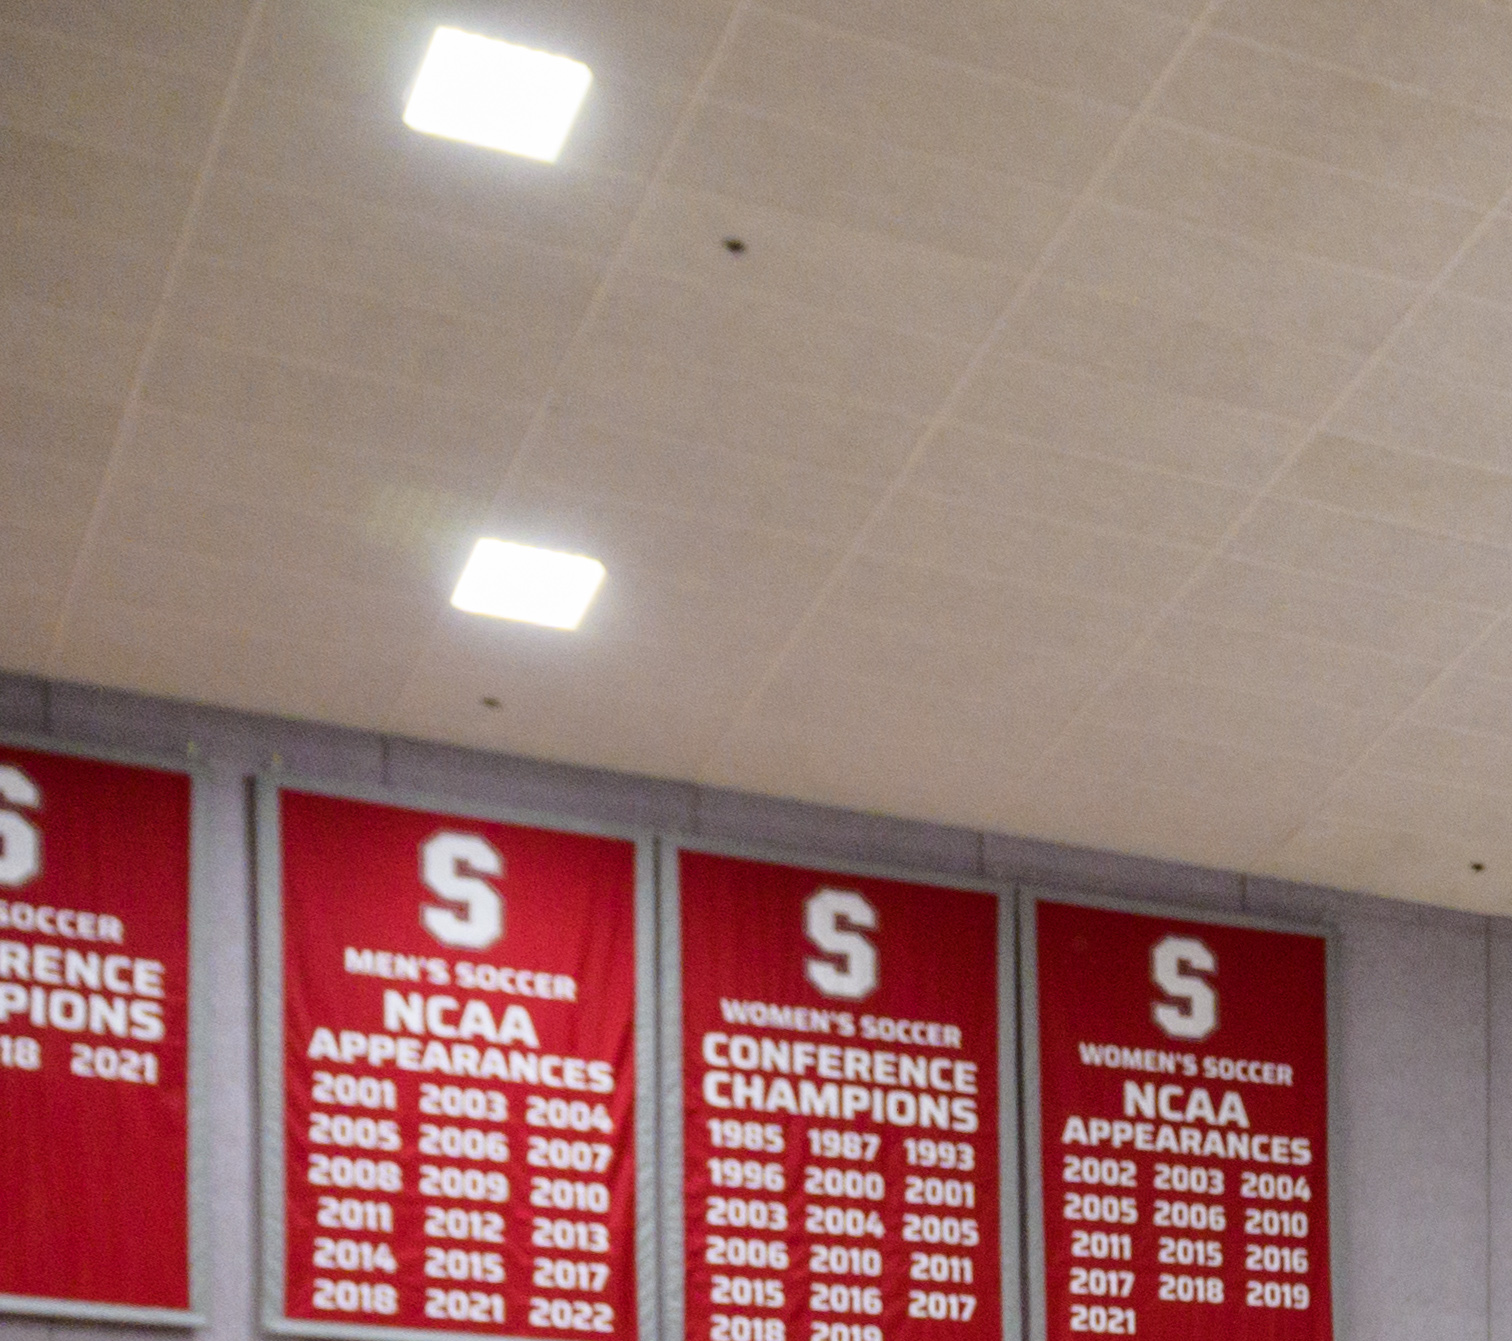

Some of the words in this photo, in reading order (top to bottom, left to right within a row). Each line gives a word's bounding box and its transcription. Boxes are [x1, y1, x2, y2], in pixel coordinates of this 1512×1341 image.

[420, 830, 504, 951] S
[805, 888, 877, 999] S
[342, 945, 451, 986] MEN'S
[453, 959, 577, 1002] SOCCER
[1151, 935, 1217, 1039] S
[382, 988, 540, 1049] NCAA
[719, 997, 856, 1037] WOMEN'S
[859, 1014, 961, 1048] SOCCER
[70, 1041, 158, 1085] 2021
[306, 1026, 615, 1094] APPEARANCES
[700, 1030, 977, 1094] CONFERENCE
[1078, 1041, 1198, 1076] WOMEN'S
[1201, 1055, 1293, 1085] SOCCER
[311, 1070, 397, 1111] 2001
[417, 1082, 508, 1122] 2003
[524, 1094, 614, 1134] 2004
[701, 1068, 979, 1133] CHAMPIONS
[1122, 1079, 1250, 1129] NCAA
[706, 1117, 786, 1153] 1985
[806, 1127, 881, 1162] 1987
[902, 1136, 975, 1171] 1993
[1060, 1114, 1312, 1166] APPEARANCES
[1061, 1153, 1137, 1188] 2002
[1152, 1161, 1225, 1196] 2003
[1239, 1170, 1312, 1202] 2004
